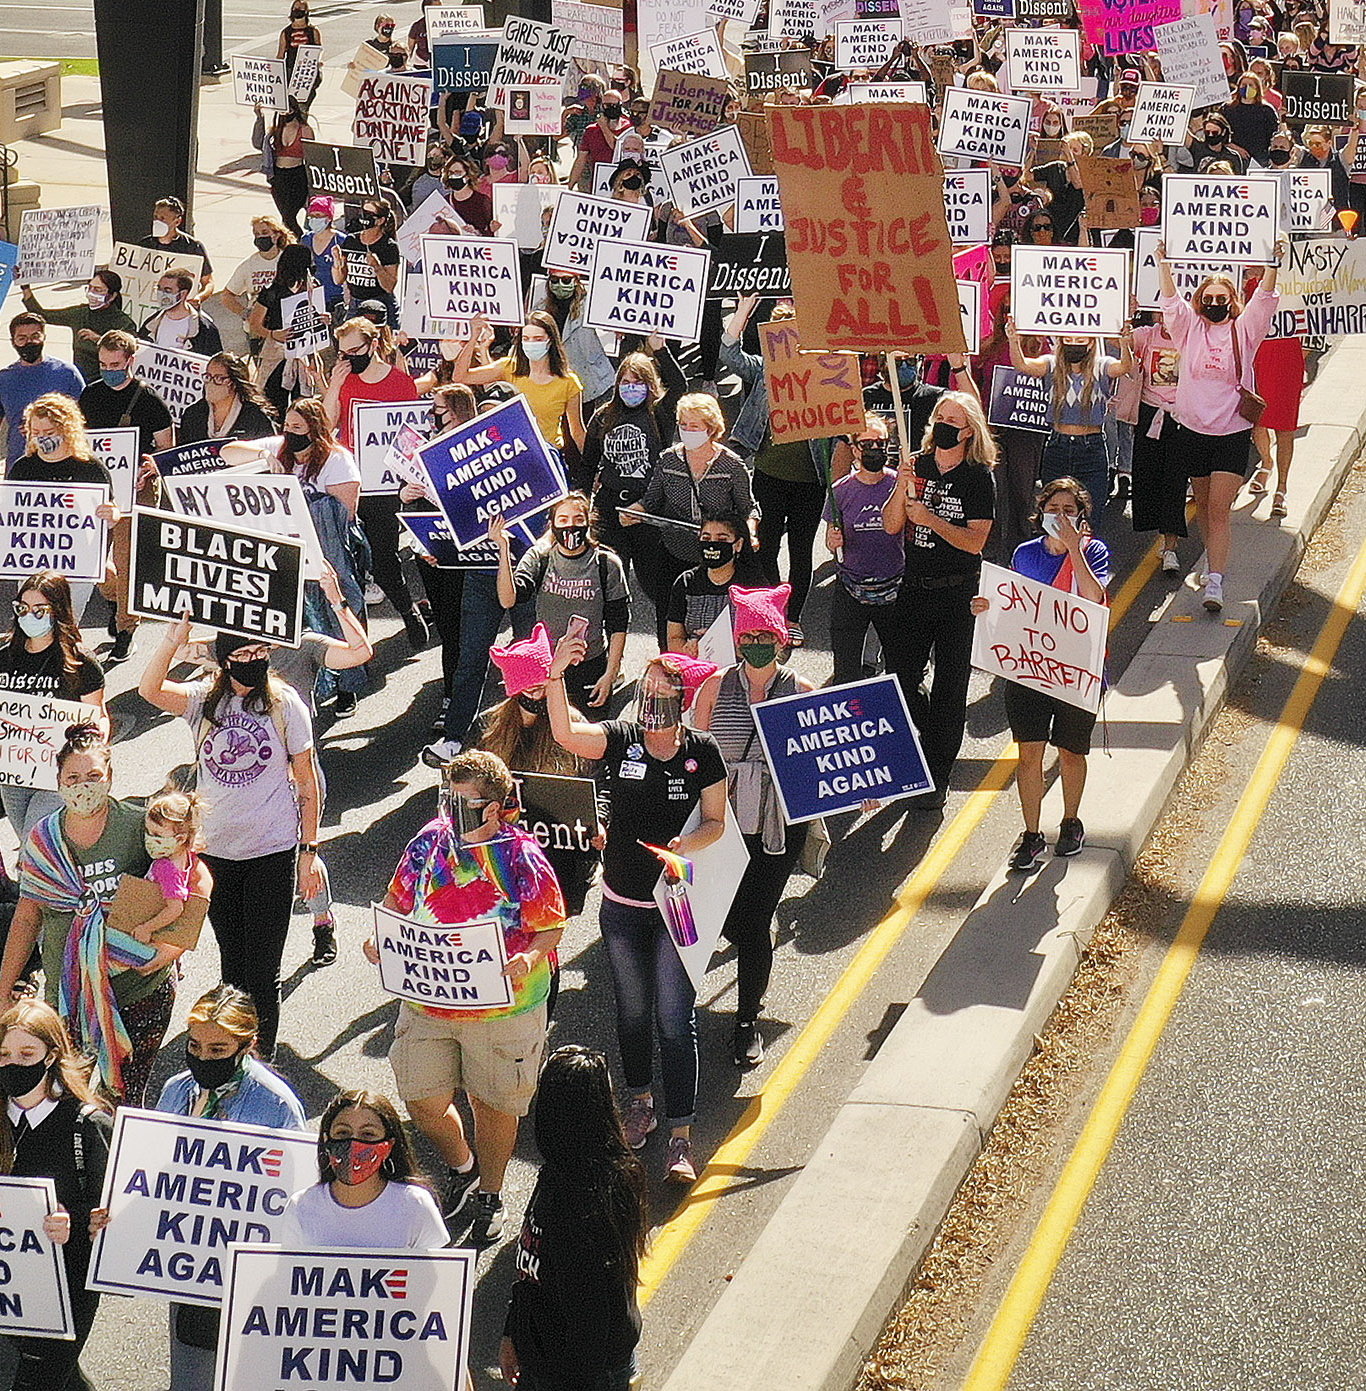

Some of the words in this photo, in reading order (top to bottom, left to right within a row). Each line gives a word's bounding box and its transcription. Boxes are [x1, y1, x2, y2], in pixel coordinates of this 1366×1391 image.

[1020, 0, 1067, 15] Dissent
[506, 21, 542, 46] GIRLS
[543, 29, 575, 56] JUST
[1025, 36, 1058, 45] MAKE
[1106, 26, 1154, 53] LIVES
[464, 48, 470, 67] I
[501, 45, 534, 68] WANNA
[538, 54, 570, 76] HAVE
[774, 54, 780, 71] I
[1013, 48, 1072, 58] AMERICA
[245, 61, 271, 72] MAKE
[438, 67, 490, 87] Dissen
[1025, 61, 1059, 71] KIND
[237, 72, 282, 84] AMERICA
[247, 83, 273, 94] KIND
[659, 74, 725, 104] Liberty
[749, 69, 808, 91] Dissent
[1023, 74, 1062, 84] AGAIN
[1314, 76, 1321, 97] I
[245, 94, 275, 106] AGAIN
[358, 79, 429, 104] AGAINST
[356, 101, 428, 123] ABORTION?
[652, 99, 718, 129] Justice
[672, 96, 691, 109] FOR
[694, 102, 718, 115] ALL
[1286, 96, 1348, 120] Dissent
[535, 122, 560, 133] NINE
[333, 148, 342, 170] I
[310, 166, 374, 195] Dissent
[1195, 185, 1248, 199] MAKE
[1173, 203, 1269, 218] AMERICA
[787, 211, 941, 258] JUSTICE
[1192, 221, 1248, 236] KIND
[754, 236, 769, 262] I
[1186, 240, 1251, 254] AGAIN
[116, 247, 175, 273] BLACK
[837, 261, 896, 295] FOR
[1302, 292, 1332, 306] VOTE
[770, 370, 812, 402] MY
[770, 399, 861, 434] CHOICE
[15, 492, 73, 508] MAKE
[175, 486, 212, 516] MY
[225, 485, 291, 516] BODY
[11, 532, 72, 549] KIND
[160, 522, 280, 571] BLACK
[563, 531, 581, 549] VOTE
[3, 553, 75, 569] AGAIN
[170, 558, 269, 602] LIVES
[545, 581, 599, 600] Almighty
[548, 572, 591, 587] Woman
[143, 583, 286, 637] MATTER
[998, 581, 1042, 623] SAY
[1054, 600, 1088, 633] NO
[1023, 628, 1055, 651] TO
[990, 641, 1100, 697] BARRETT
[797, 699, 864, 727] MAKE
[787, 718, 894, 756] AMERICA
[9, 747, 36, 764] FOR
[816, 746, 875, 772] KIND
[214, 767, 255, 781] FARMS
[819, 766, 892, 798] AGAIN
[400, 923, 462, 946] MAKE
[384, 934, 493, 964] AMERICA
[404, 961, 470, 982] KIND
[403, 978, 478, 999] AGAIN
[291, 1267, 407, 1299] MAKE
[242, 1306, 447, 1340] AMERICA
[281, 1348, 402, 1382] KIND
